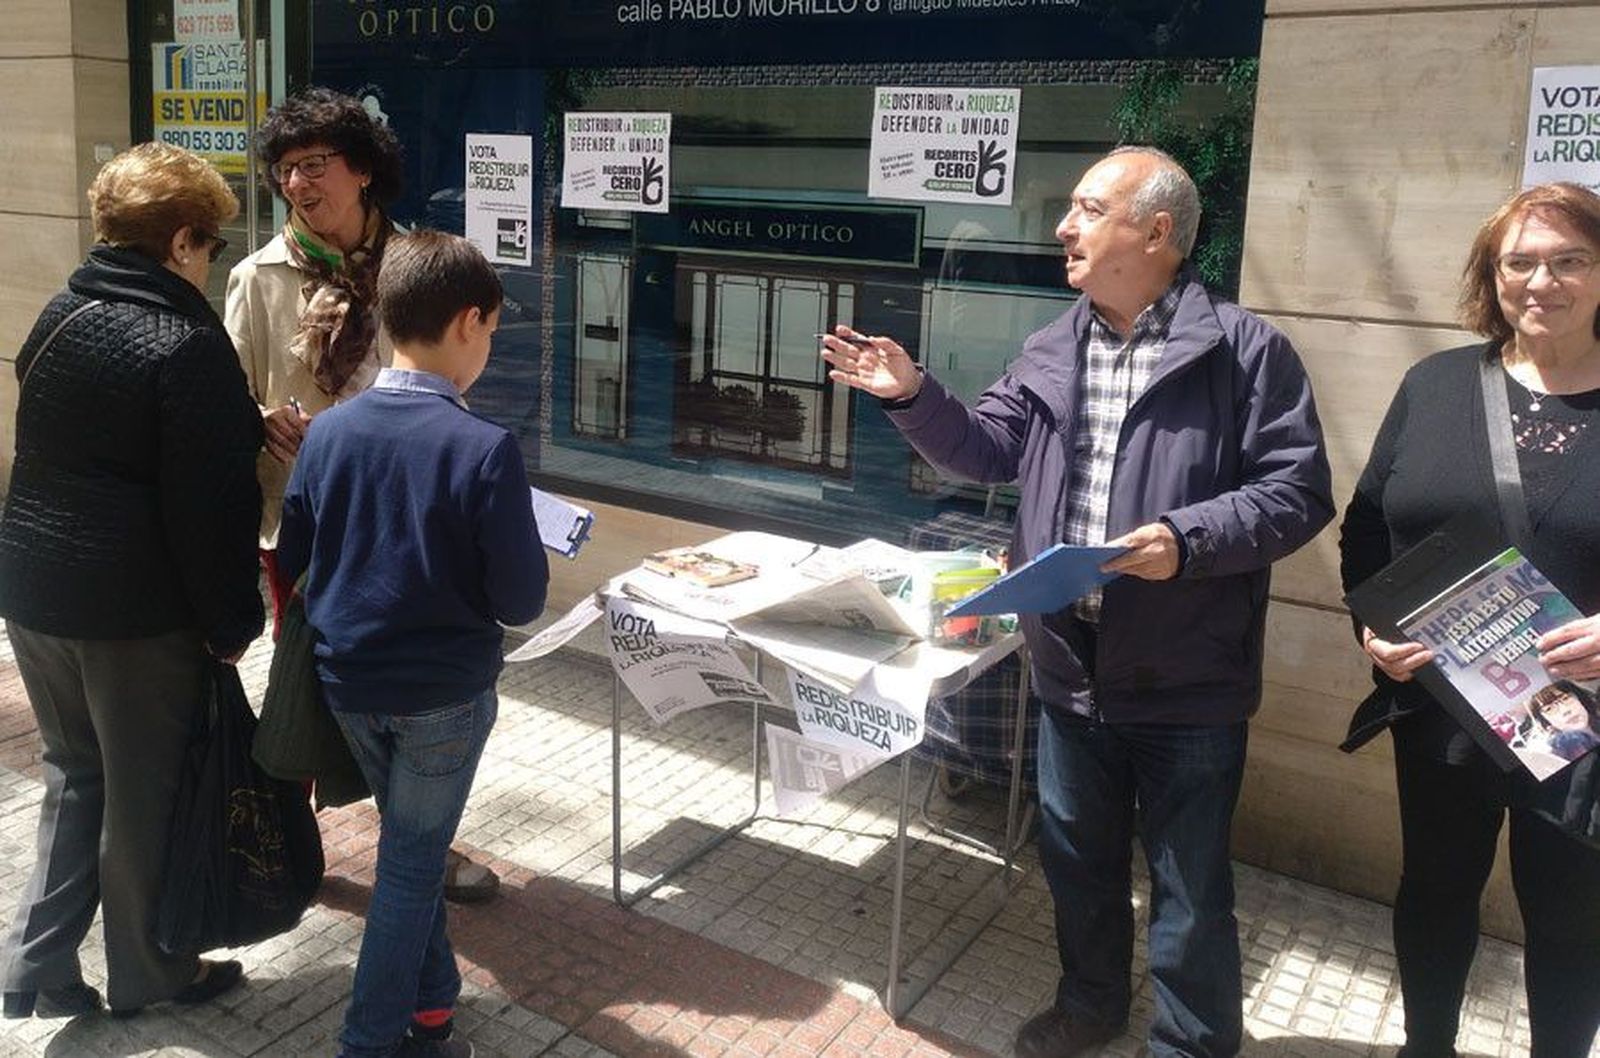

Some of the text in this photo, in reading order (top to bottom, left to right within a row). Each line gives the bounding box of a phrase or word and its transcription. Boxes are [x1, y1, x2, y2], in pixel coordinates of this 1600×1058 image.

[360, 4, 494, 36] OPTICO
[618, 2, 662, 22] calle
[669, 0, 741, 20] PABLO
[749, 0, 858, 17] MORILLO
[161, 98, 245, 122] SE VEND
[879, 93, 1015, 113] REDISTRIBUIR LA RIQUEZA
[568, 118, 622, 132] REDISTRIBUIR
[881, 115, 1009, 135] DEFENDER LA UNIDAD
[193, 131, 211, 150] 53
[215, 131, 234, 150] 30
[570, 137, 615, 151] DEFENDER
[629, 138, 664, 153] UNIDAD
[469, 145, 497, 158] VOTA
[924, 149, 978, 162] RECORTES
[1533, 150, 1550, 163] LA
[468, 161, 529, 176] REDISTRIBUIR
[602, 165, 642, 176] RECORTES
[934, 162, 976, 179] CERO
[475, 176, 515, 191] RIQUEZA
[611, 176, 641, 190] CERO
[688, 218, 854, 243] ANGEL OPTICO
[1482, 601, 1501, 619] ES
[1499, 586, 1520, 606] TU
[611, 610, 657, 639] VOTA
[1458, 598, 1541, 664] ALTERNATIVA
[795, 683, 917, 740] REDISTRIBUIR
[814, 707, 892, 752] RIQUEZA
